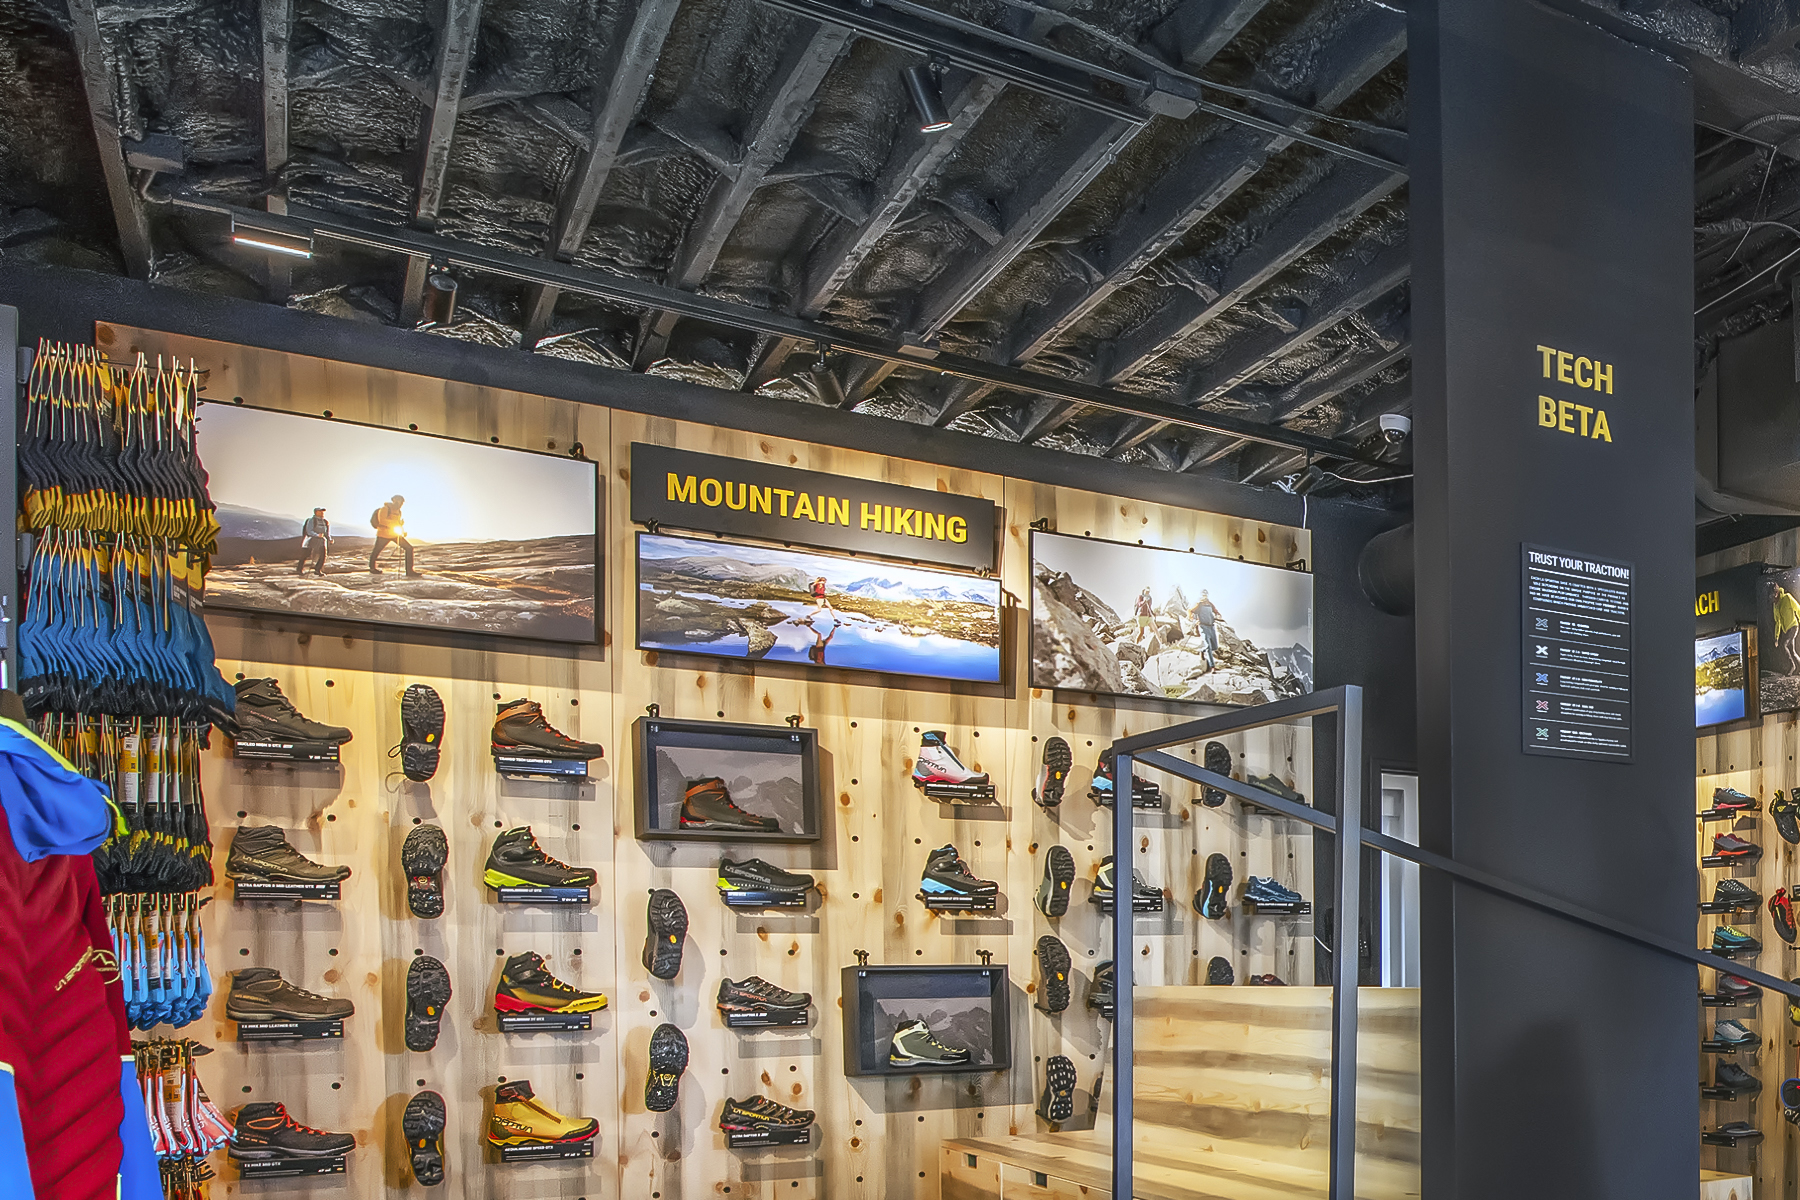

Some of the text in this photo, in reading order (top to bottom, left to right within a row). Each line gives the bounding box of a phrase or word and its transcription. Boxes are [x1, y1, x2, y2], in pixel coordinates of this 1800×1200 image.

[1536, 344, 1614, 395] TECH
[1538, 395, 1613, 443] BETA
[666, 472, 968, 543] MOUNTAIN HIKING
[1528, 551, 1630, 580] TRUST YOUR TRACTION!
